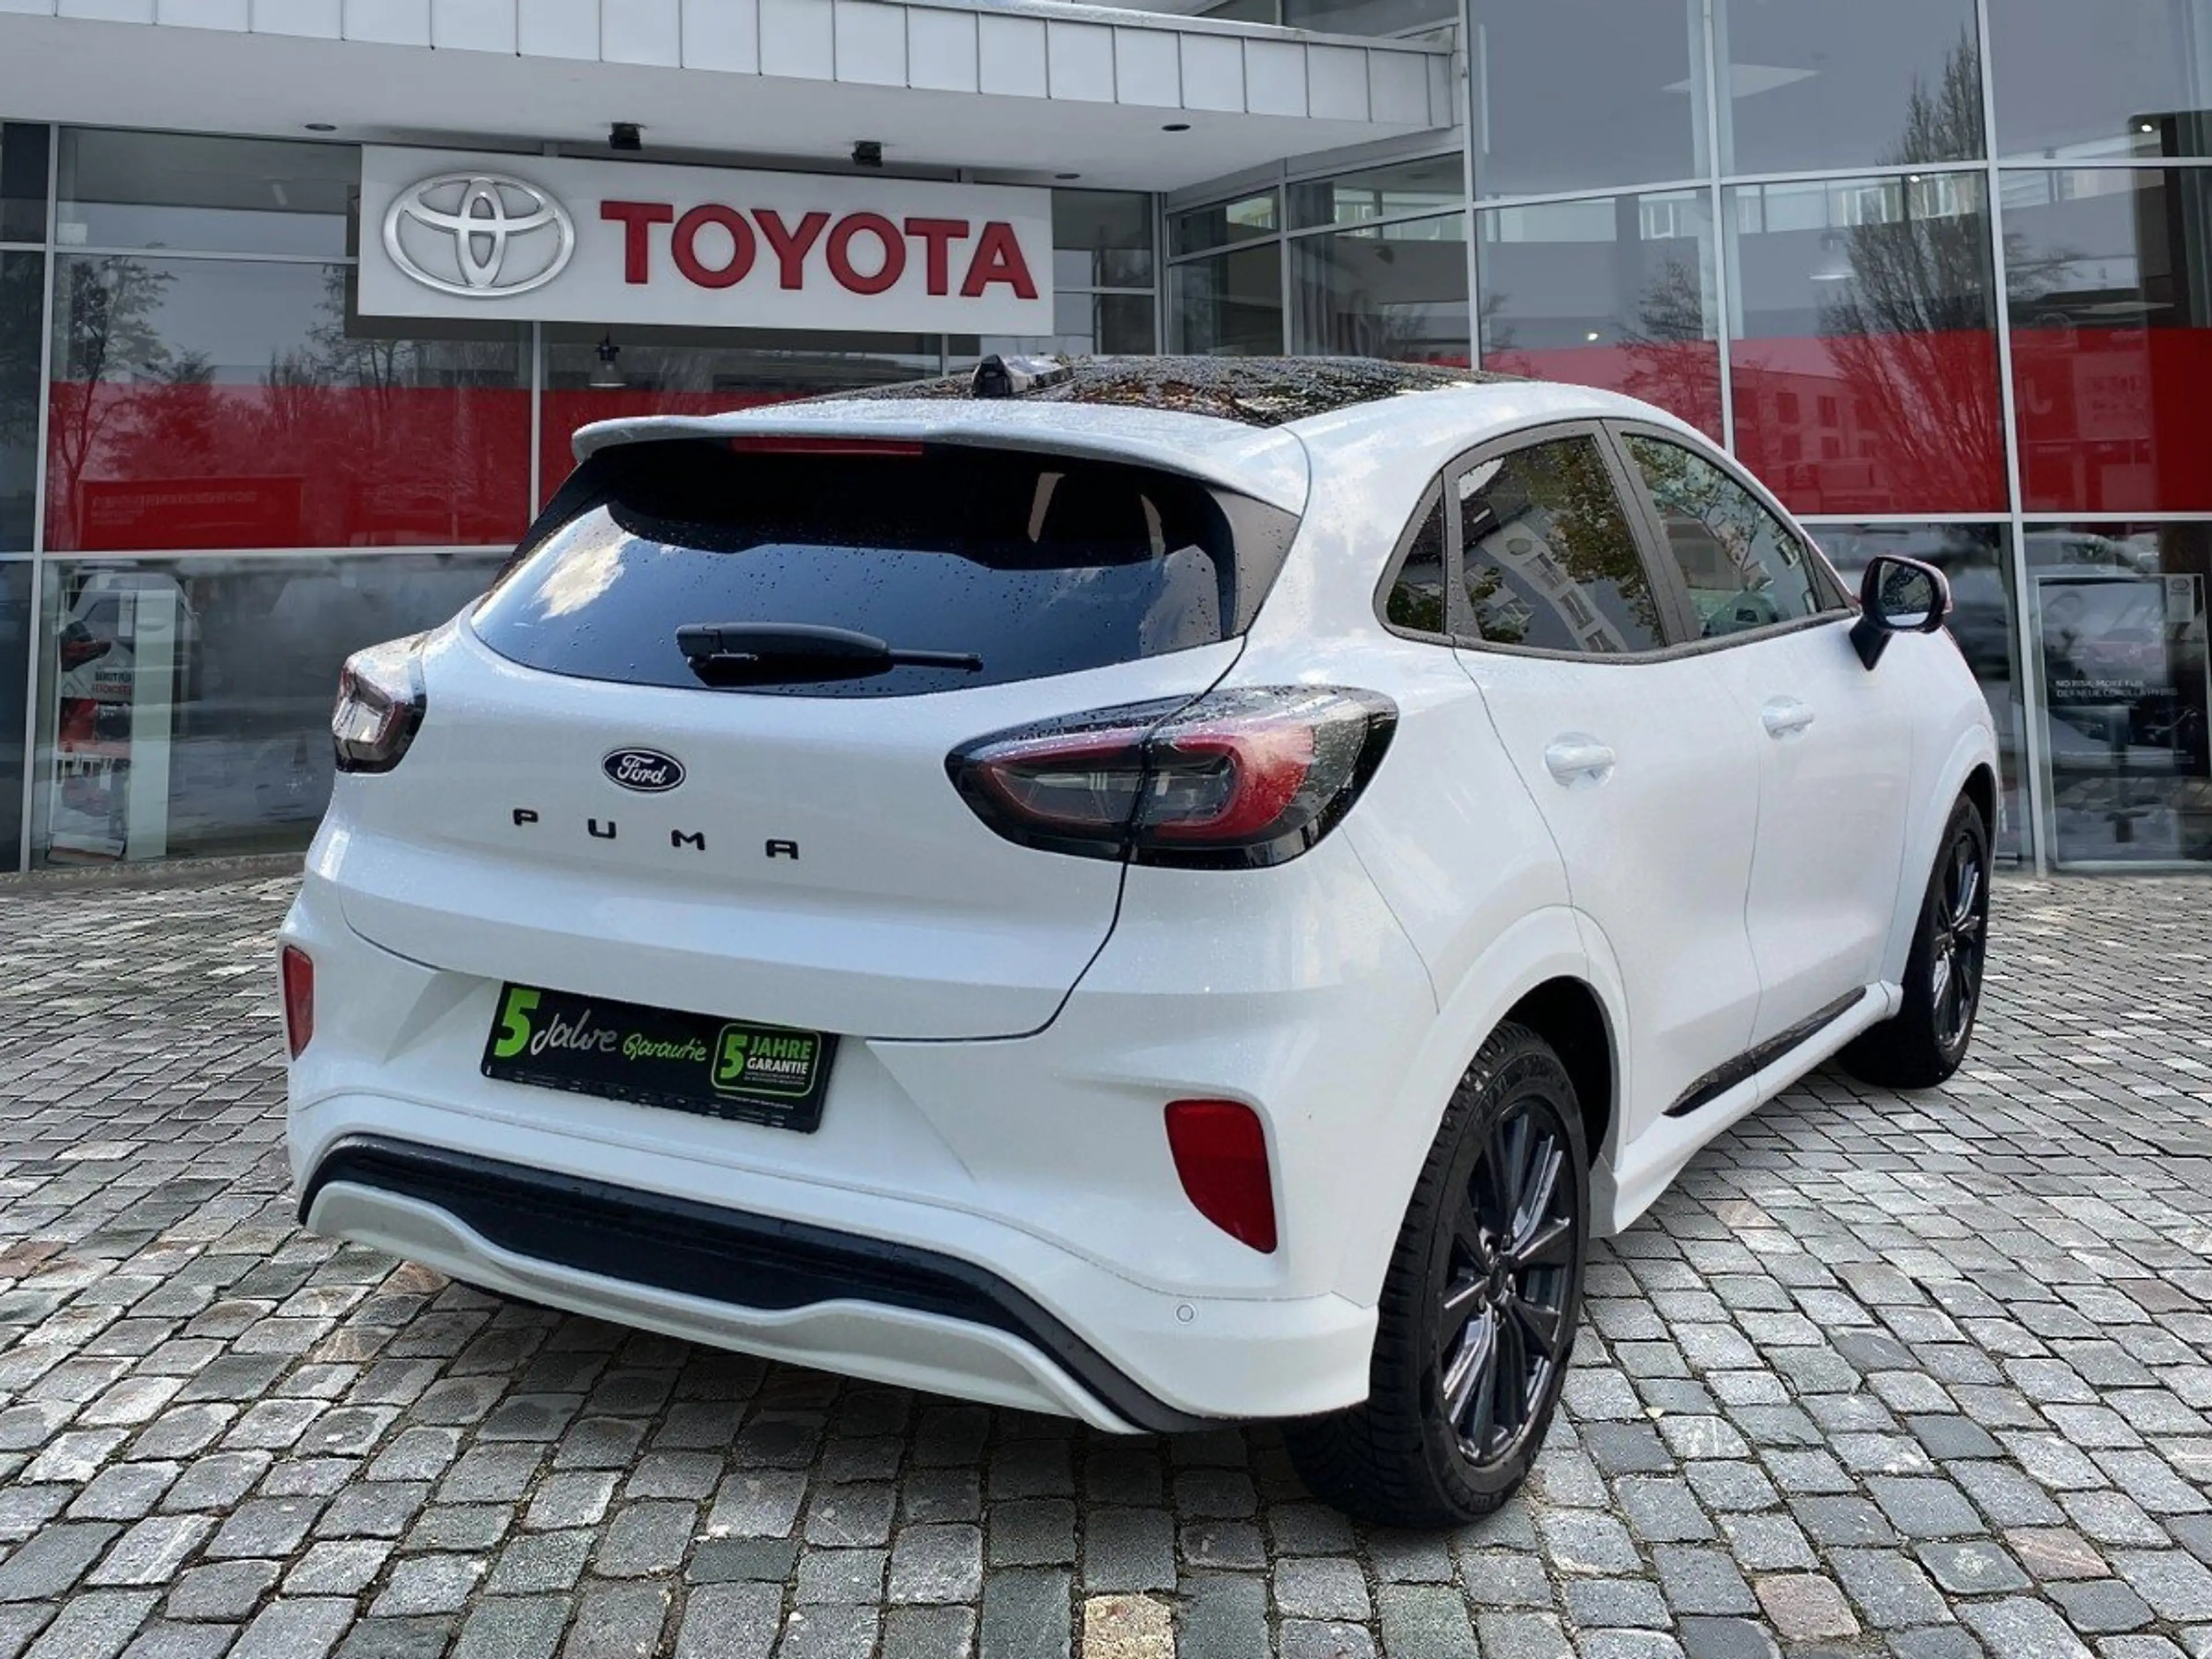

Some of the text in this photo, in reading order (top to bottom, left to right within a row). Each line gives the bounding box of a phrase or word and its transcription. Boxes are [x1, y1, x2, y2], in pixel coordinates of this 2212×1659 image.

[600, 200, 1039, 299] TOYOTA
[617, 753, 667, 784] Ford
[513, 808, 800, 860] PUMA
[494, 987, 708, 1062] 5 Jahre Garantie
[720, 1034, 748, 1079] 5
[749, 1036, 813, 1060] JAHRE
[746, 1056, 809, 1074] GARANTIE
